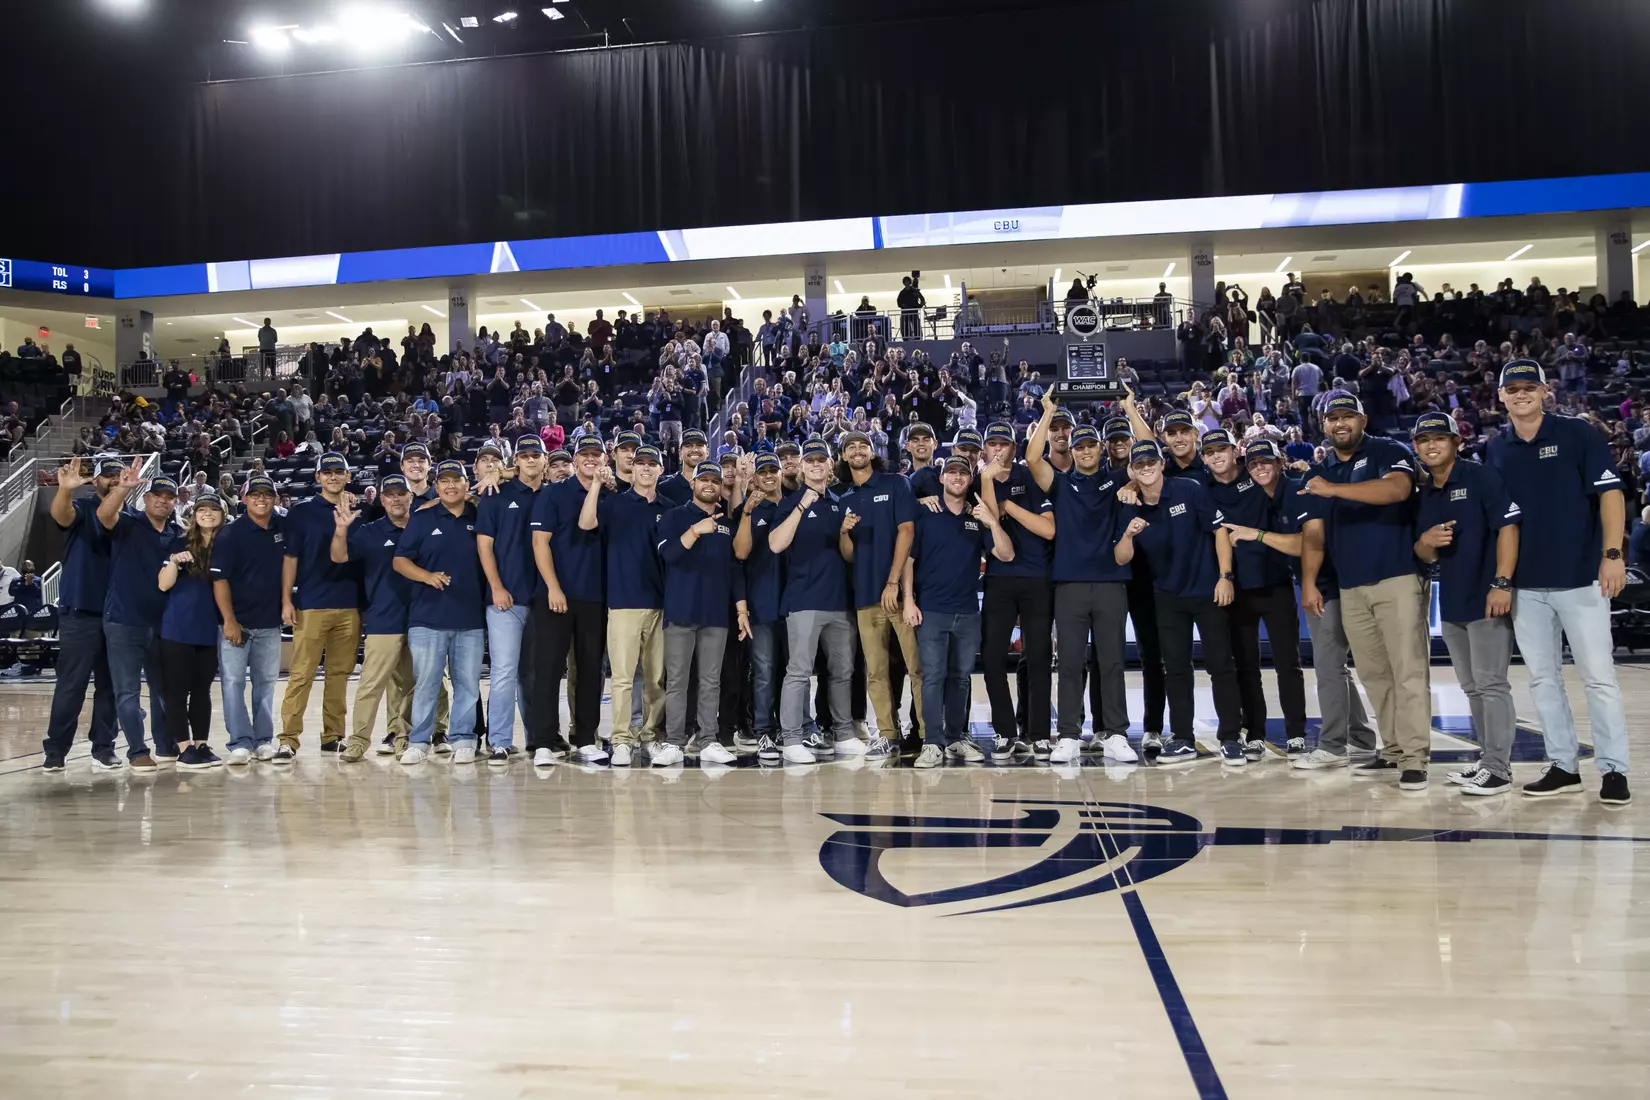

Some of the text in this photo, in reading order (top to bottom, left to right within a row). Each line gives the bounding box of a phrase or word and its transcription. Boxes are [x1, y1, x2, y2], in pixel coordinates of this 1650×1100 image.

[994, 220, 1019, 230] CBU
[52, 266, 89, 279] TOL 3
[52, 280, 89, 292] FLS 0
[1073, 315, 1097, 325] WAC
[1539, 445, 1558, 456] CBU
[1010, 485, 1025, 493] CBU
[1450, 488, 1467, 498] CBU
[873, 494, 889, 503] CBU
[1169, 503, 1186, 514] CBU
